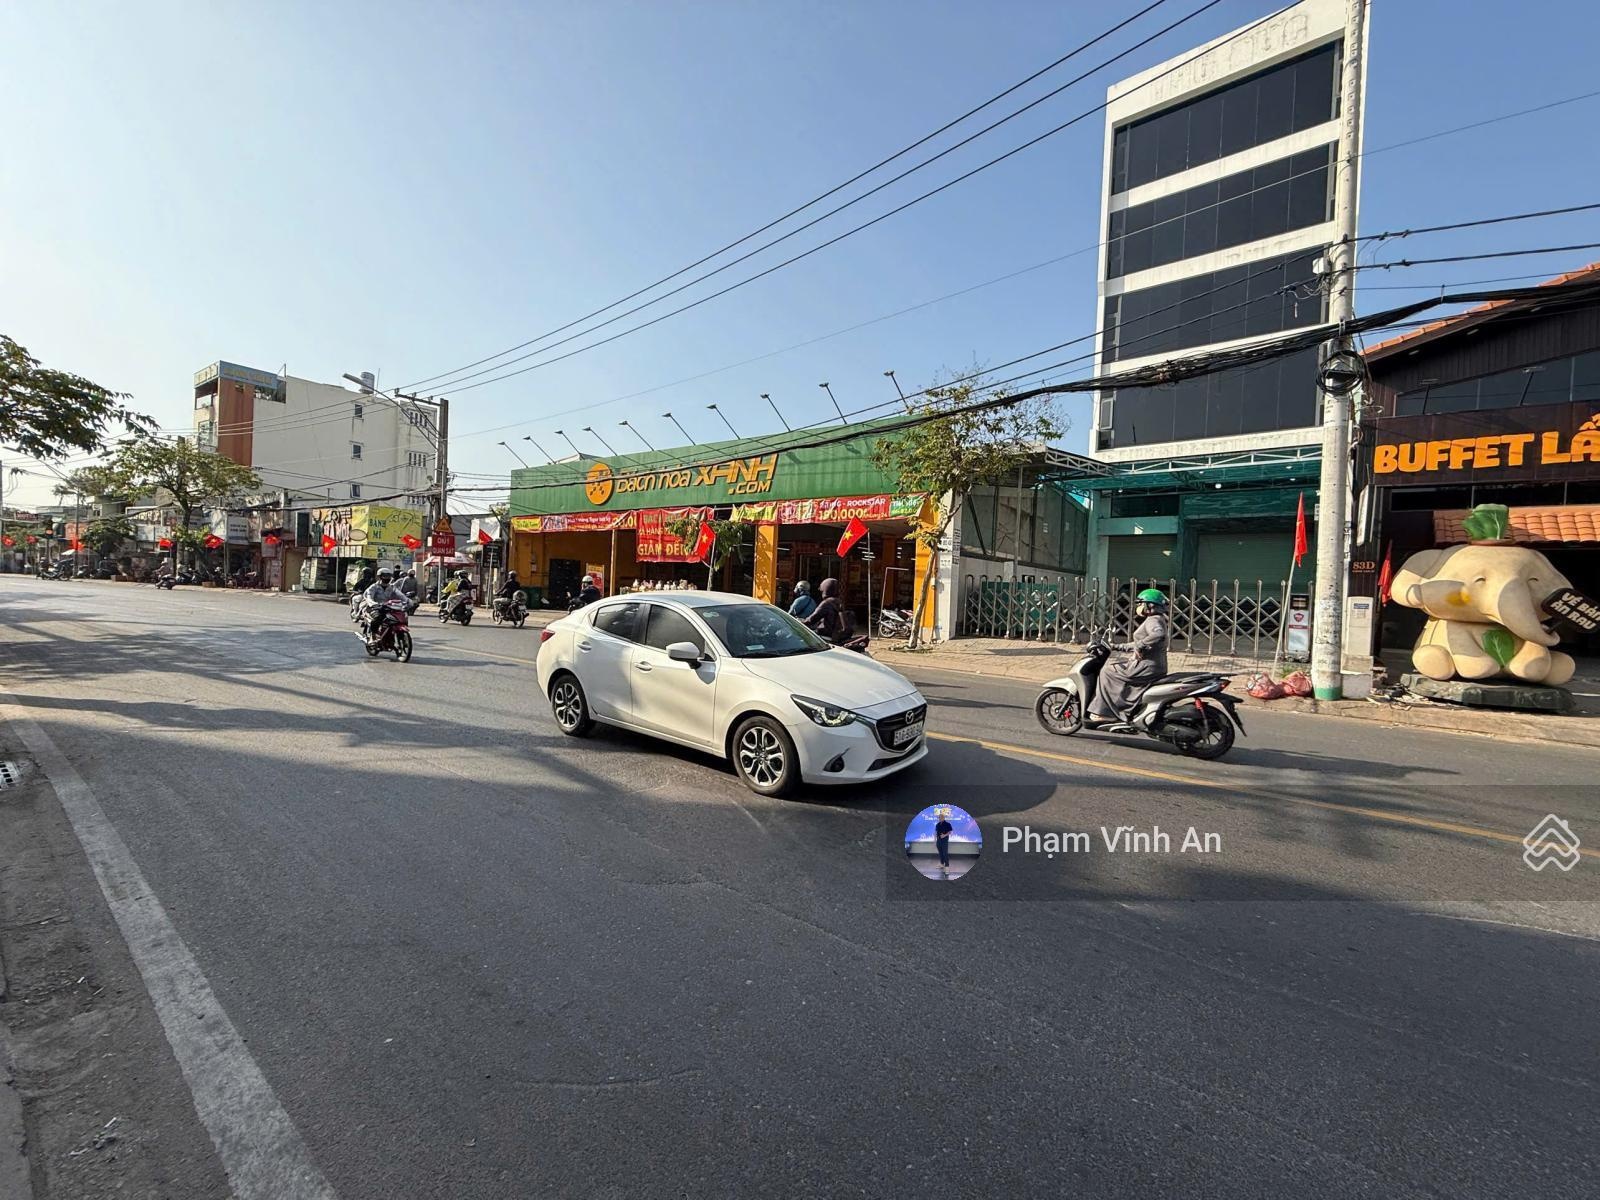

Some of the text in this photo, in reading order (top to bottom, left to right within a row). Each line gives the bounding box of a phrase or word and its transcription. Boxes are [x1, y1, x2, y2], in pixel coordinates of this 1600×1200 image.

[694, 452, 780, 487] XANH
[1374, 433, 1535, 473] BUFFET
[1567, 611, 1597, 629] RAU
